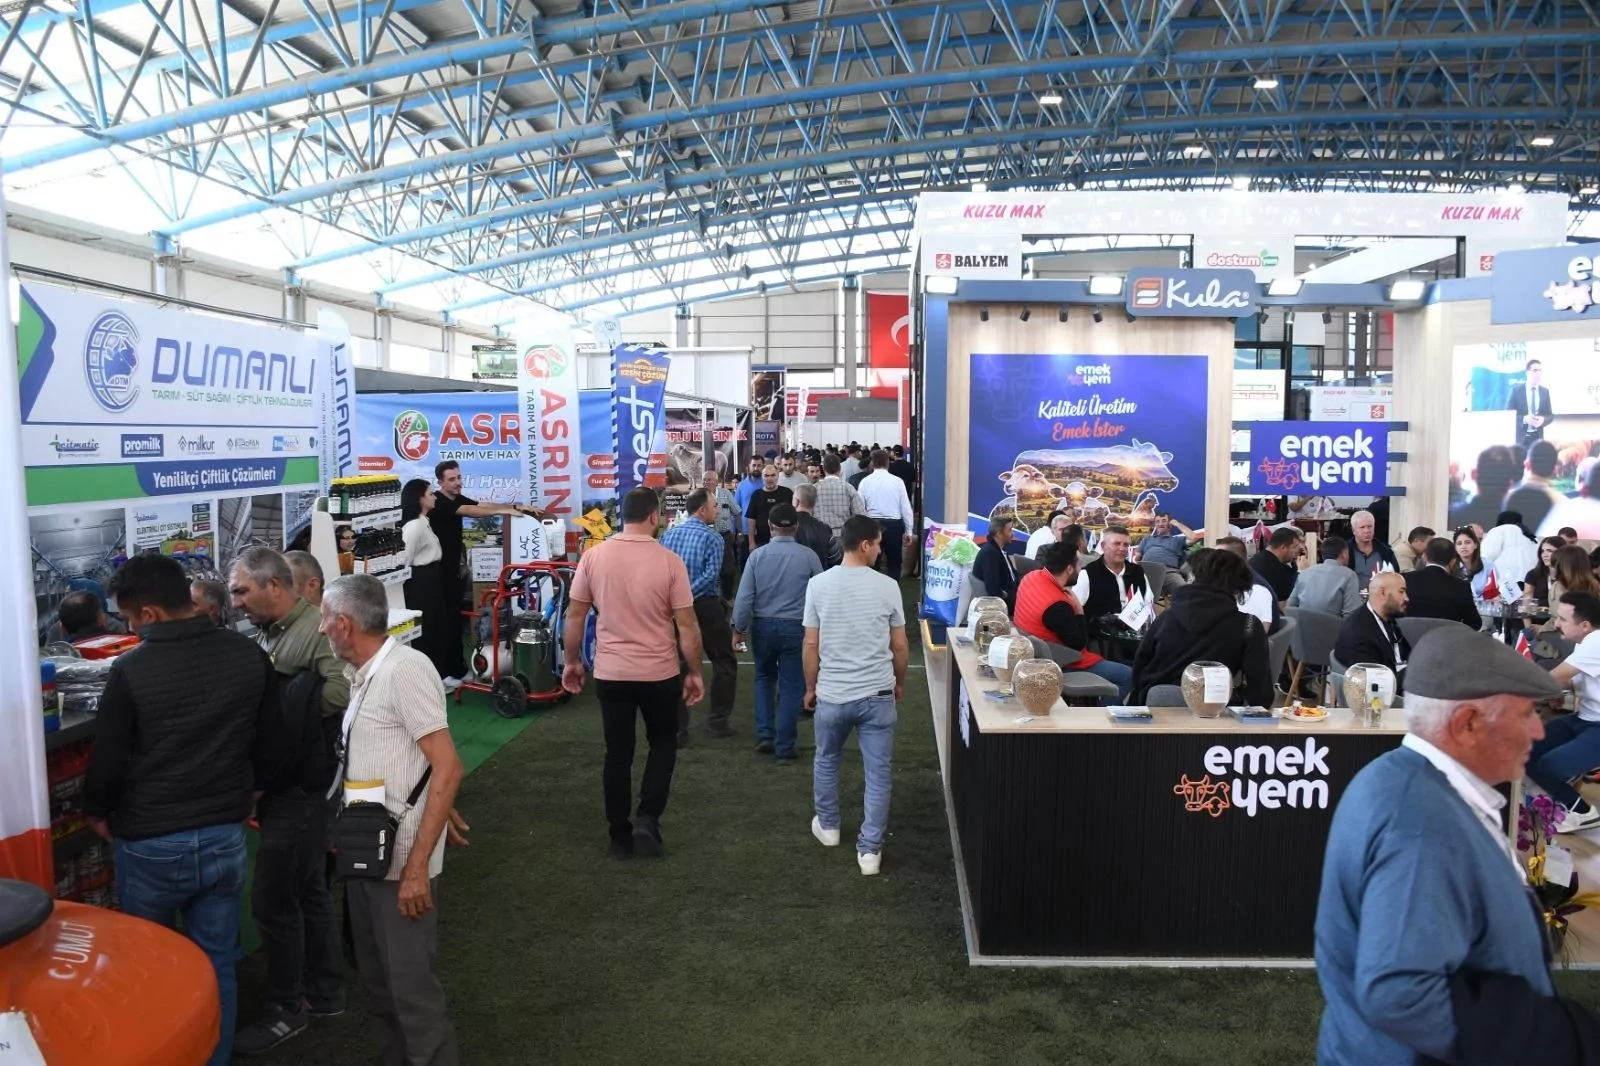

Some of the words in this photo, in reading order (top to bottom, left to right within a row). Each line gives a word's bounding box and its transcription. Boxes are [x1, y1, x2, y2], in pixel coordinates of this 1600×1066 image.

[963, 204, 1007, 218] KUZU
[1009, 204, 1046, 218] MAX
[1441, 206, 1485, 220] KUZU
[1487, 206, 1523, 220] MAX
[954, 255, 1009, 267] BALYEM
[1207, 252, 1260, 267] dostum
[1167, 277, 1249, 309] Kula
[151, 337, 316, 395] DUMANLI
[1075, 363, 1111, 375] emek
[1083, 374, 1111, 387] yem
[152, 389, 181, 401] TARIM
[526, 389, 536, 423] TARIM
[1038, 398, 1088, 420] Kaliteli
[1088, 394, 1138, 416] Üretim
[439, 413, 521, 446] ASR
[527, 427, 536, 440] VE
[619, 385, 655, 487] nest
[1052, 421, 1092, 442] Emek
[1092, 416, 1126, 438] İster
[124, 436, 161, 455] promilk
[187, 434, 216, 451] milkur
[440, 451, 475, 460] TARIM
[478, 450, 494, 460] VE
[540, 388, 573, 514] ASRIN
[1280, 428, 1374, 459] emek
[153, 470, 199, 490] Yenilikçi
[200, 467, 231, 489] Çiftlik
[231, 466, 276, 487] Çözümleri
[1300, 460, 1374, 491] yem
[1203, 736, 1330, 776] emek
[1231, 778, 1329, 817] yem
